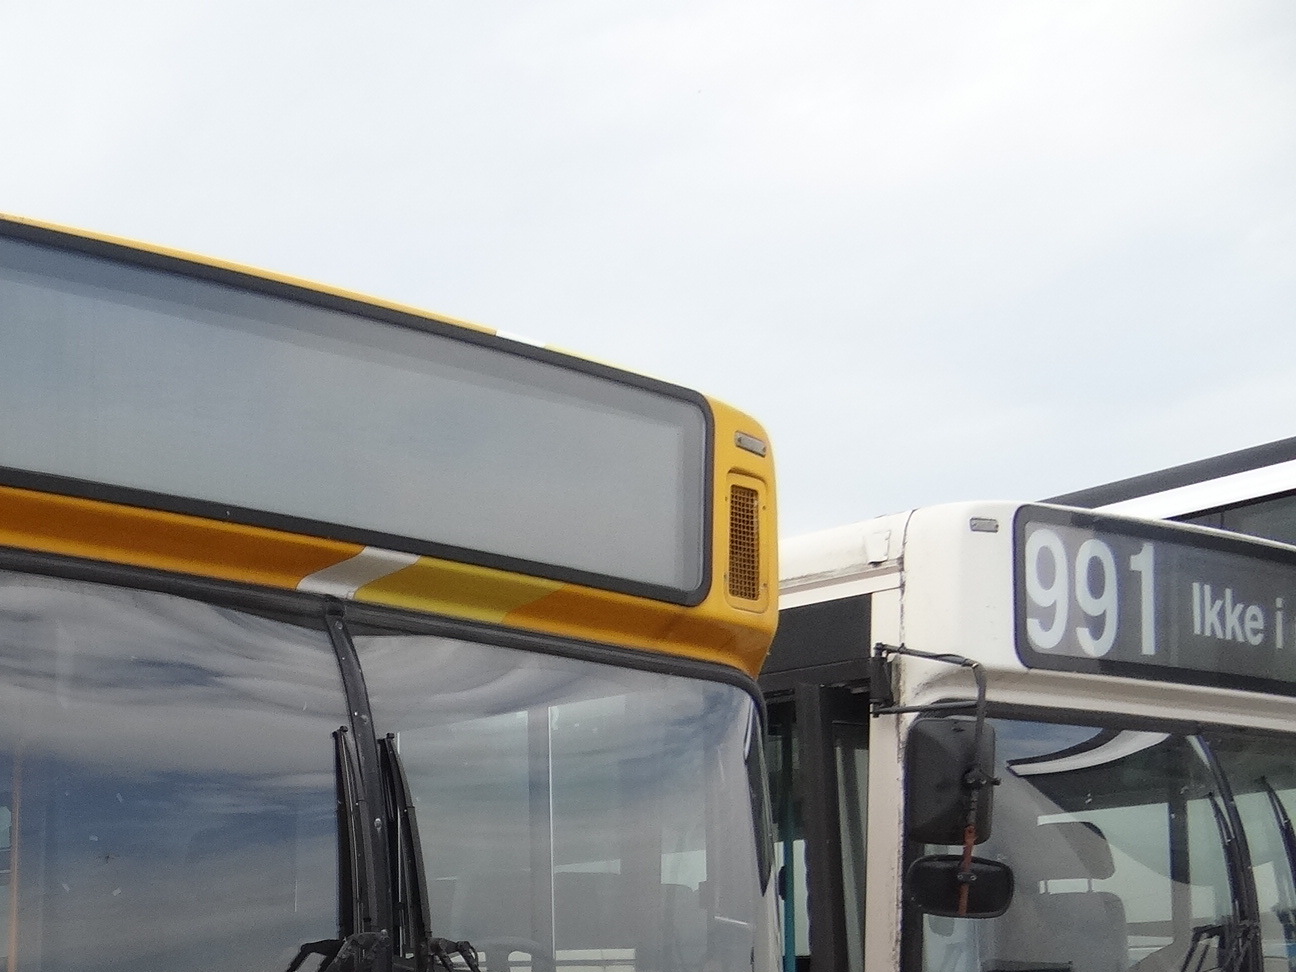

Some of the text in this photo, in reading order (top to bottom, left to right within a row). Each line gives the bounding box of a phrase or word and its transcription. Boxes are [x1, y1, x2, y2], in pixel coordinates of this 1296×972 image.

[1025, 529, 1284, 657] 991 Ikke i
